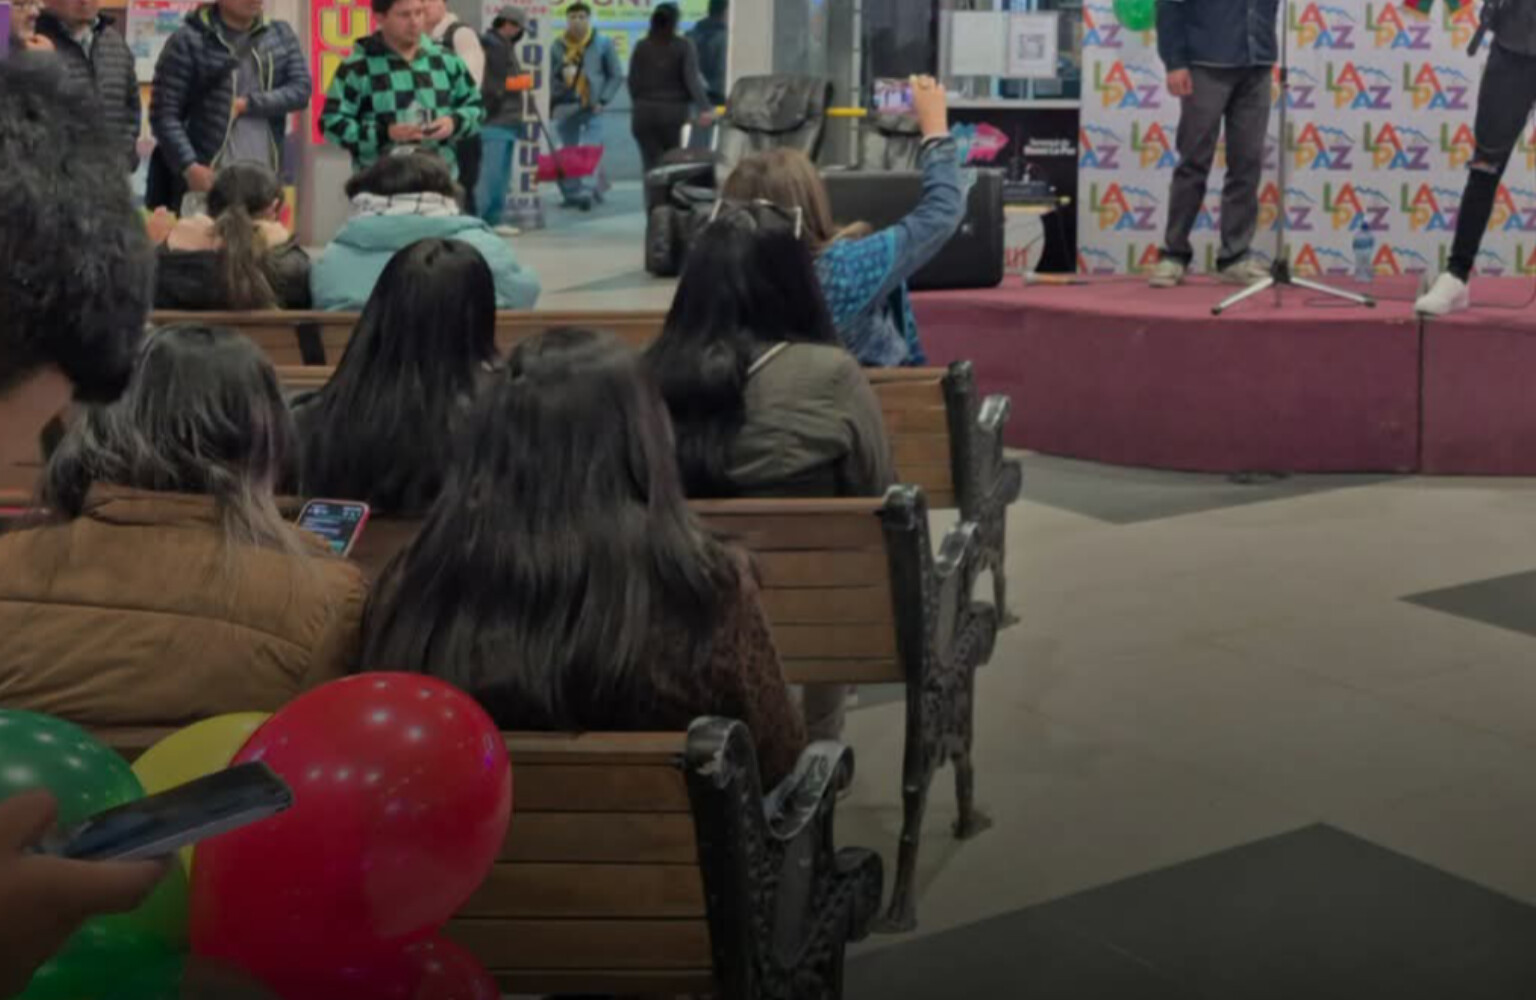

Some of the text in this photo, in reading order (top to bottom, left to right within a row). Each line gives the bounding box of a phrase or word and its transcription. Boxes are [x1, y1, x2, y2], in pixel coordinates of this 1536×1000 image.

[1289, 1, 1328, 31] LA
[1366, 1, 1405, 31] LA
[1082, 23, 1125, 49] AZ
[1298, 23, 1356, 50] PAZ
[1375, 23, 1433, 50] PAZ
[1093, 60, 1133, 91] LA
[1326, 60, 1365, 91] LA
[1403, 61, 1443, 92] LA
[1102, 83, 1160, 109] PAZ
[1334, 83, 1392, 111] PAZ
[1412, 84, 1470, 111] PAZ
[1131, 121, 1171, 151] LA
[1363, 121, 1402, 152] LA
[1079, 144, 1120, 170] AZ
[1295, 145, 1353, 171] PAZ
[1373, 145, 1430, 171] PAZ
[1090, 181, 1130, 213] LA
[1323, 181, 1363, 213] LA
[1401, 182, 1440, 213] LA
[1099, 205, 1157, 232] PAZ
